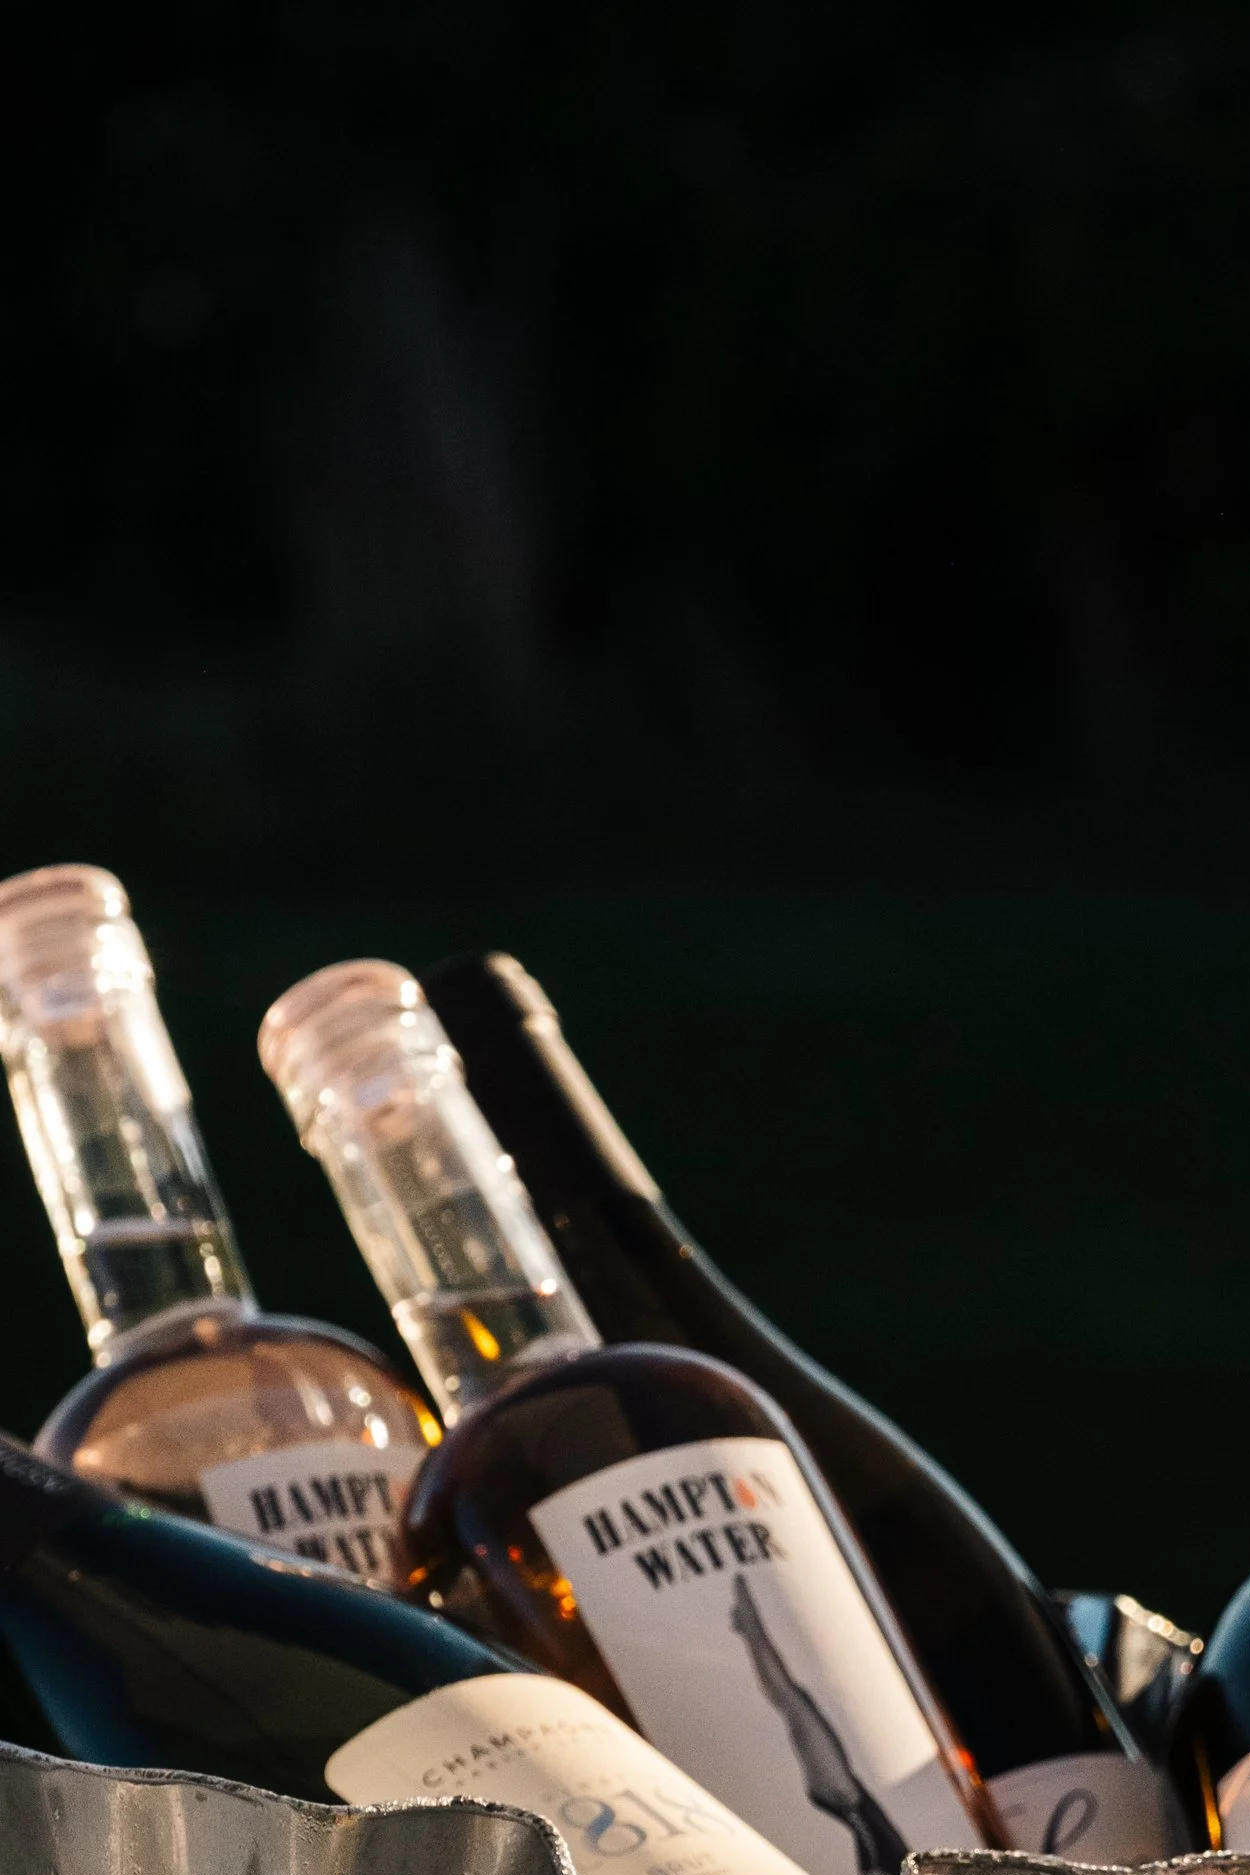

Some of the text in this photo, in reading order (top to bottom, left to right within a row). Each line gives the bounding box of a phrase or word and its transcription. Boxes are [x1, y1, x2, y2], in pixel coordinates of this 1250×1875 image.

[251, 1471, 393, 1533] HAMPT
[295, 1527, 394, 1576] WAT
[634, 1519, 787, 1590] WATER
